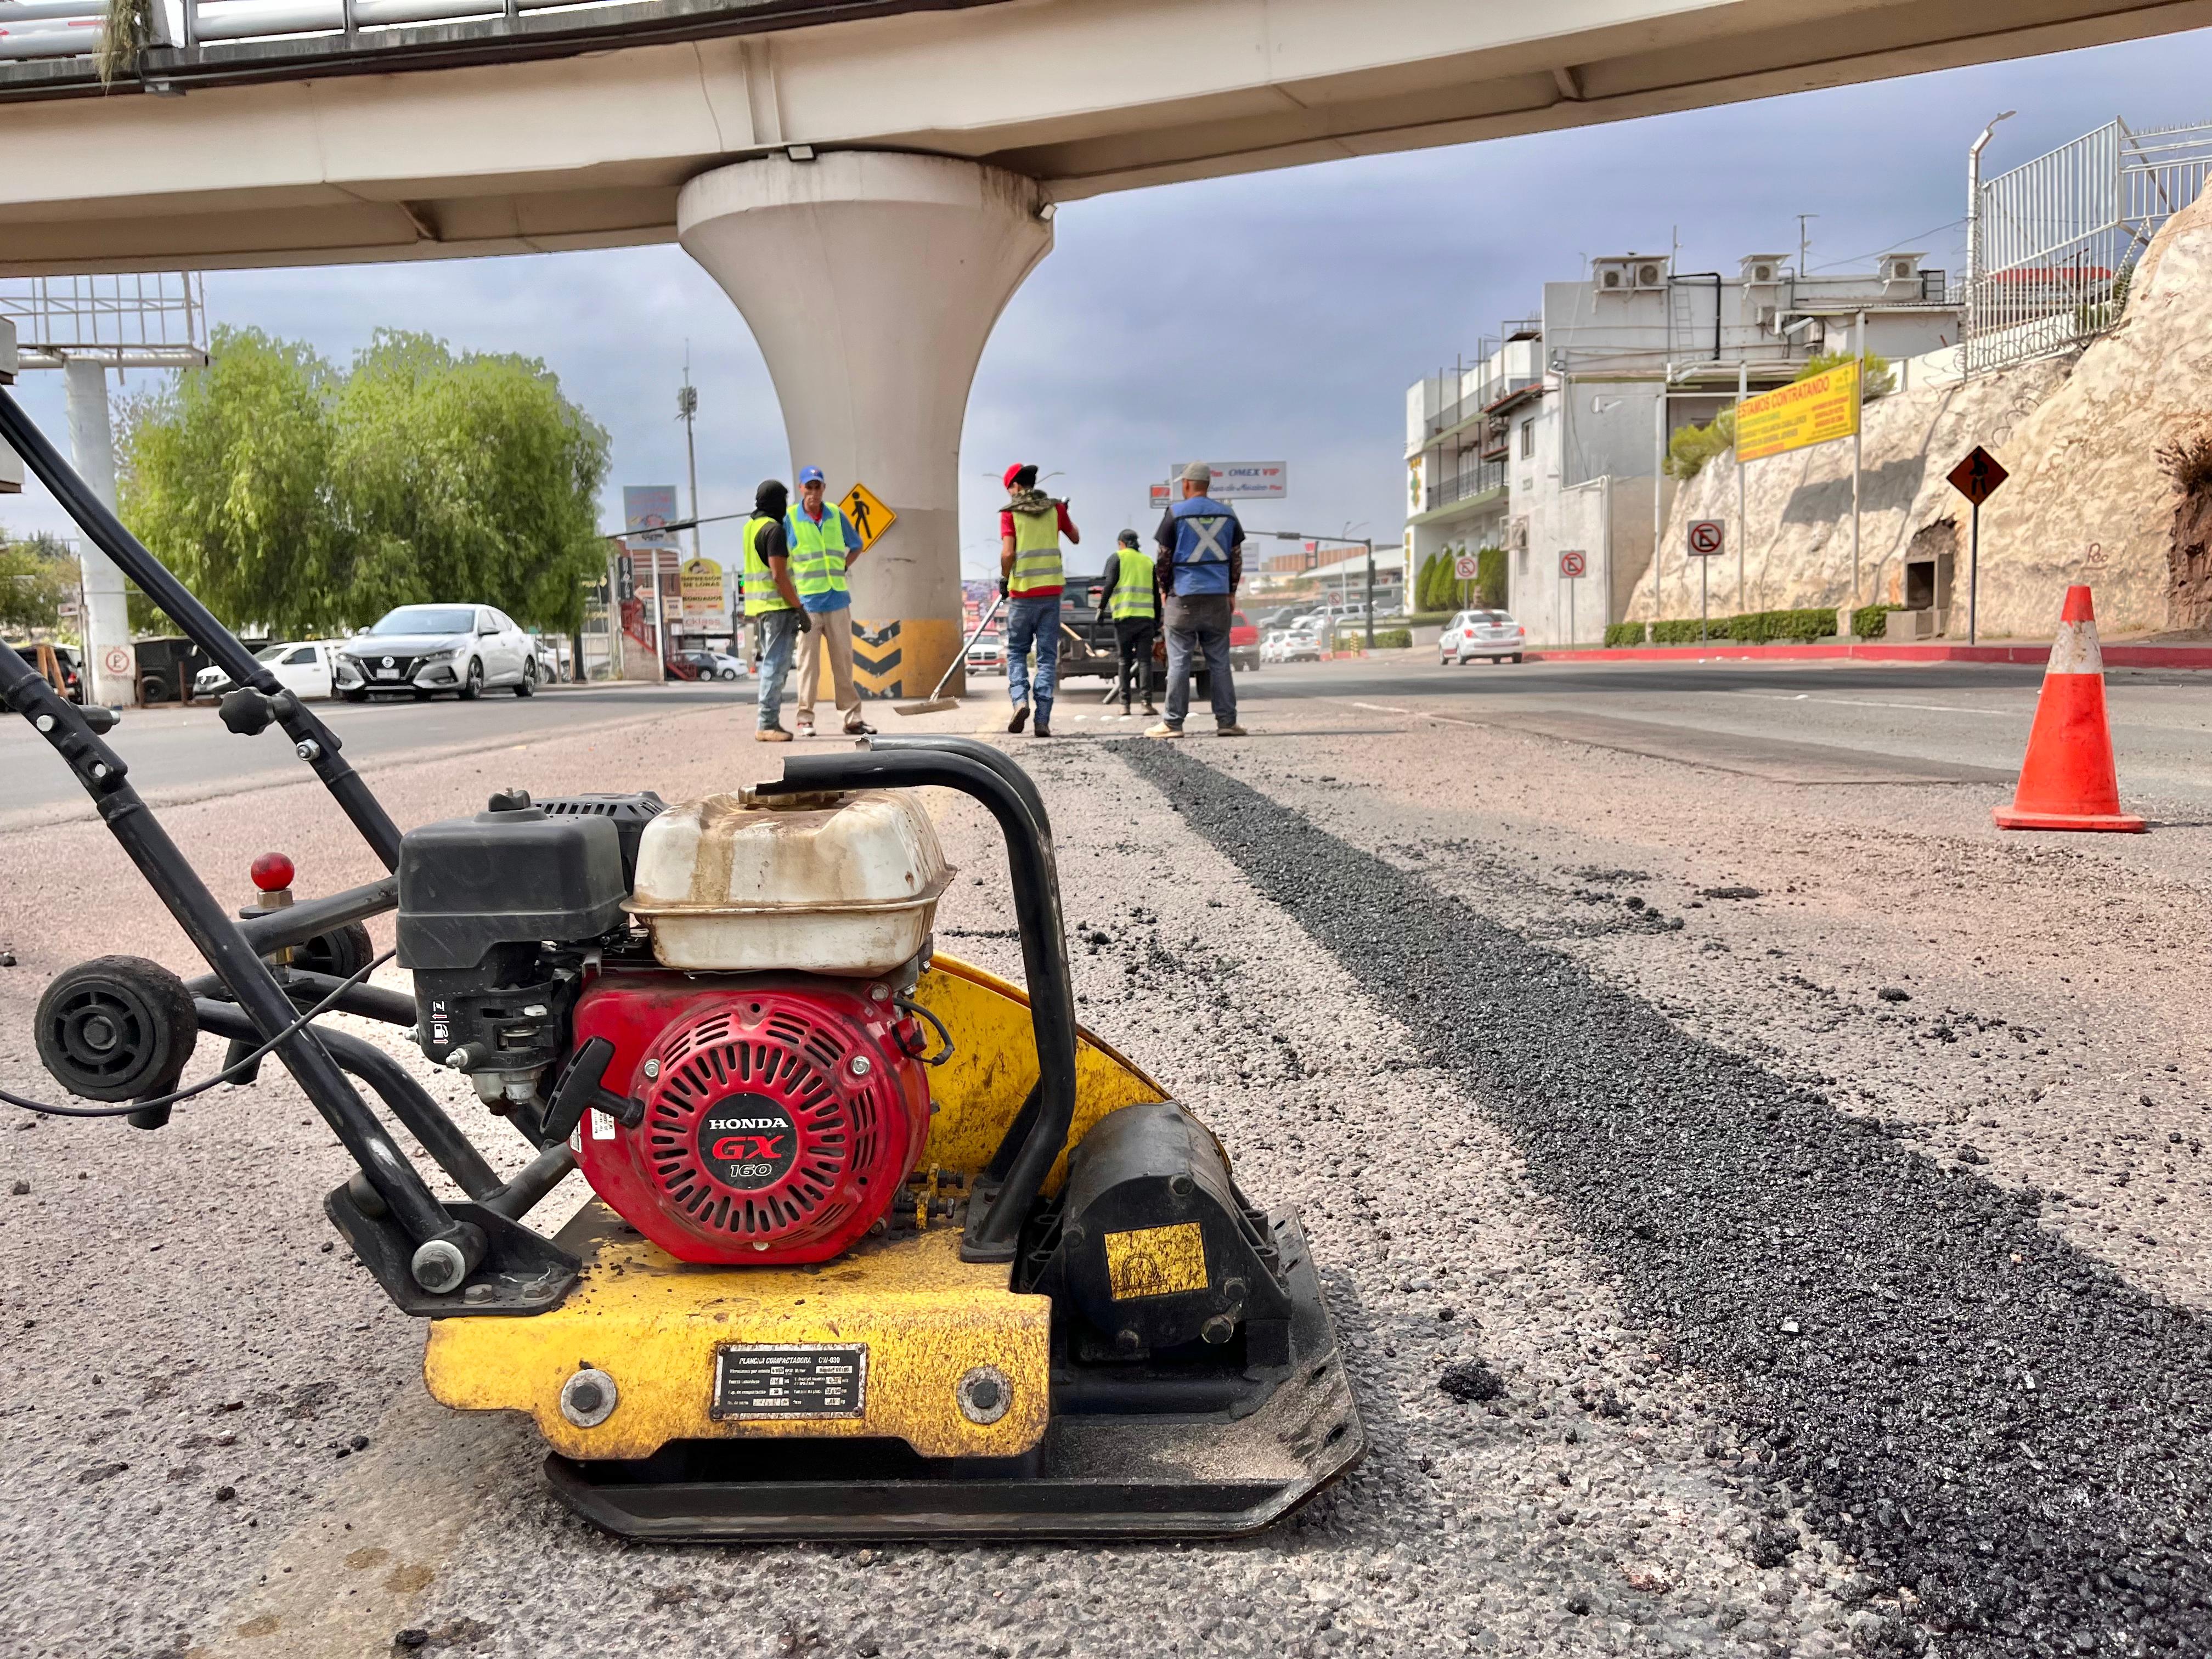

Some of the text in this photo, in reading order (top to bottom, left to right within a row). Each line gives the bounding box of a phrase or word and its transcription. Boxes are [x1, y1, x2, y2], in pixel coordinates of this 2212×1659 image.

[1737, 396, 1770, 419] ESTAMOS
[1773, 376, 1830, 409] CONTRATANDO
[709, 1118, 788, 1130] HONDA
[712, 1135, 785, 1160] GX
[730, 1163, 772, 1177] 160
